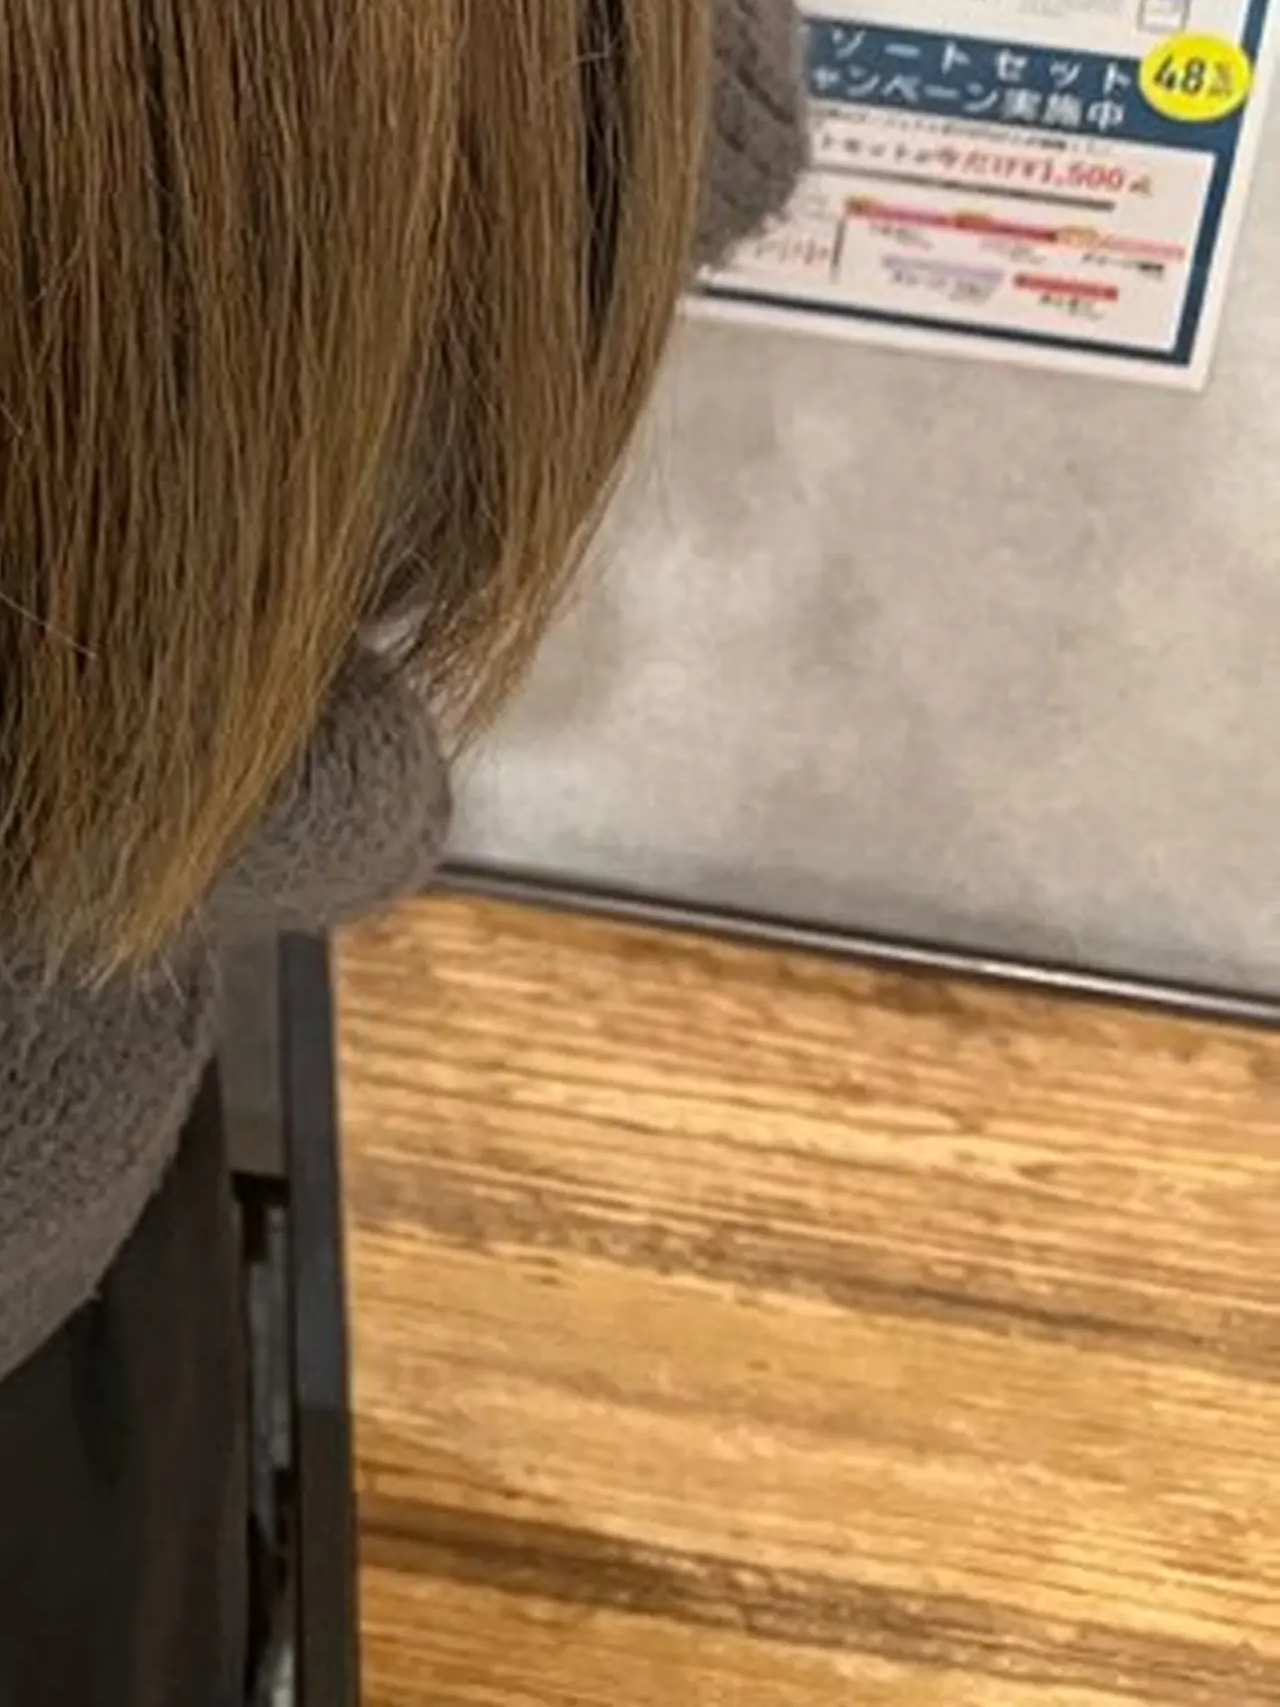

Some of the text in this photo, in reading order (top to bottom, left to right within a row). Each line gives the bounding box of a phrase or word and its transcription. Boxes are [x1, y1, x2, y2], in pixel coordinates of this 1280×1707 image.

[798, 24, 1133, 95] ソートセット
[811, 67, 1126, 133] ャンペーン実施中
